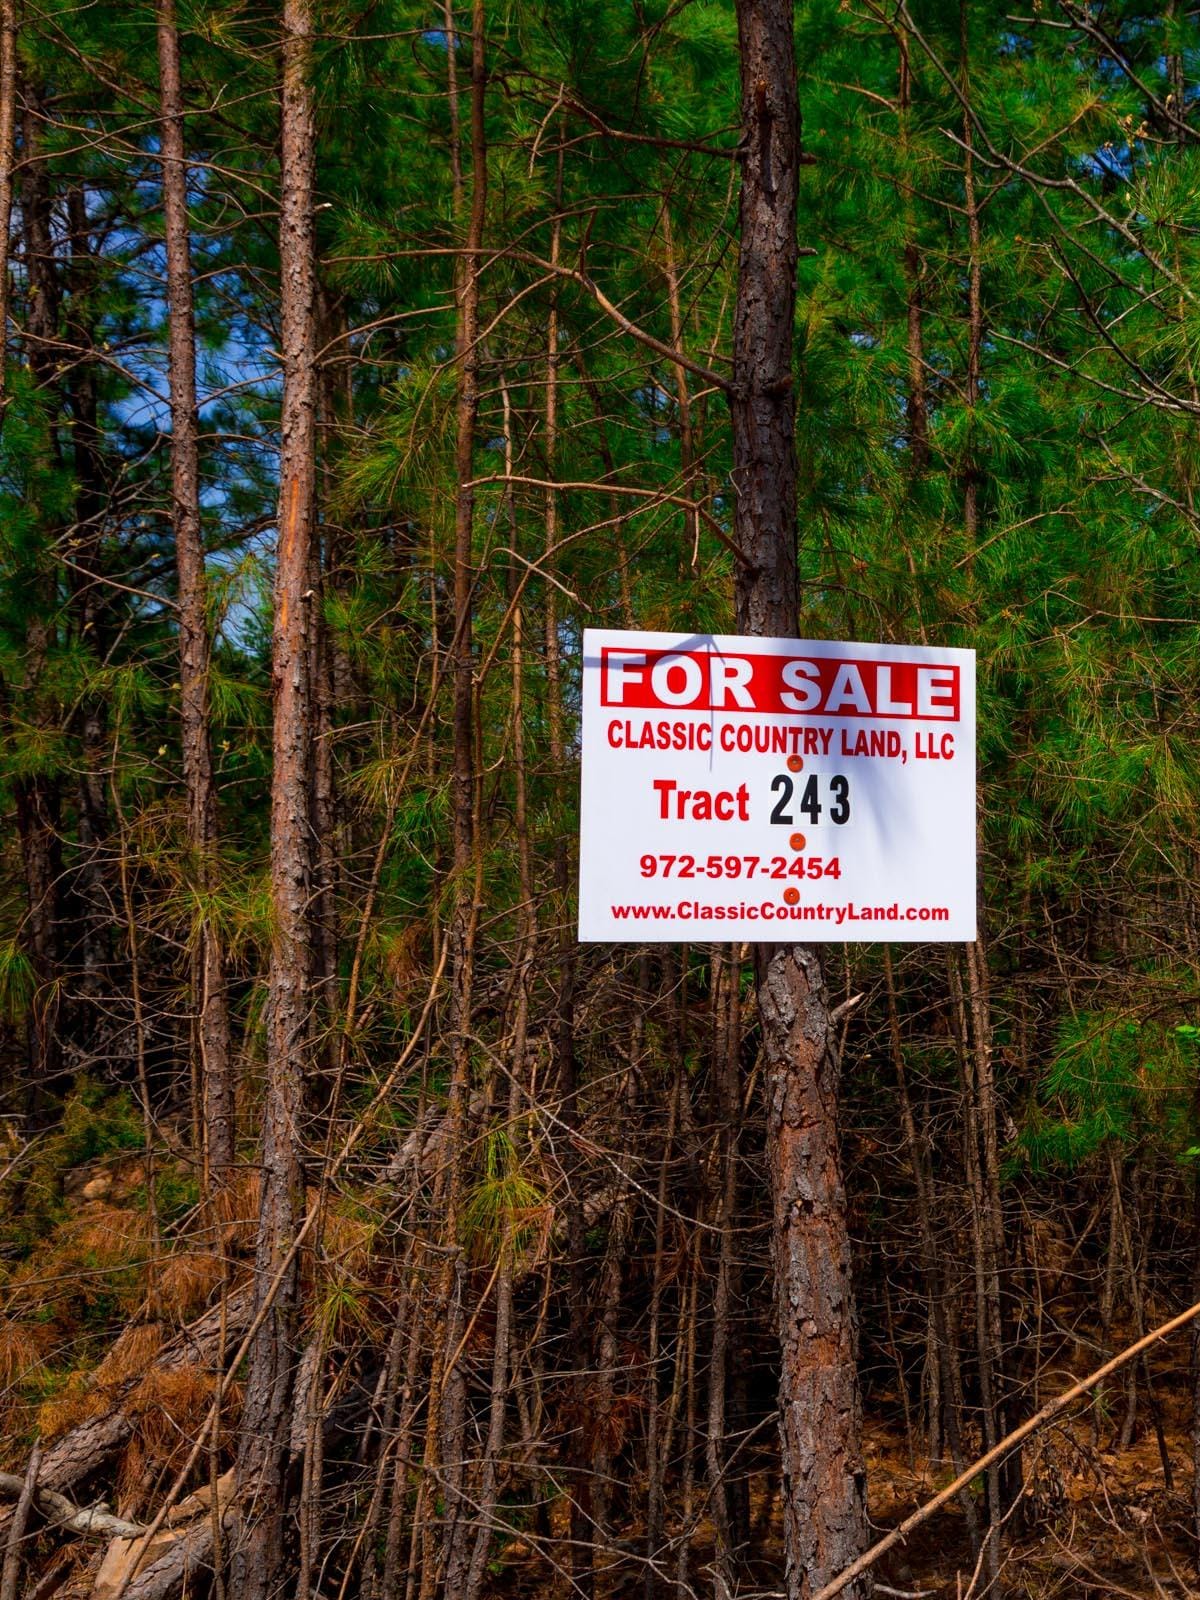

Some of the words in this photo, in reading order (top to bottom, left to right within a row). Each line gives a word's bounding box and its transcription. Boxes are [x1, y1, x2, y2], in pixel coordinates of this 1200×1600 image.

[606, 651, 756, 709] FOR
[780, 661, 955, 718] SALE
[607, 719, 712, 751] CLASSIC
[720, 724, 834, 755] COUNTRY
[841, 729, 907, 764] LAND,
[915, 732, 954, 760] LLC
[654, 779, 750, 821] Tract
[770, 774, 850, 825] 243
[640, 854, 841, 880] 972-597-2454
[611, 902, 950, 924] www.ClassicCountryLand.com
